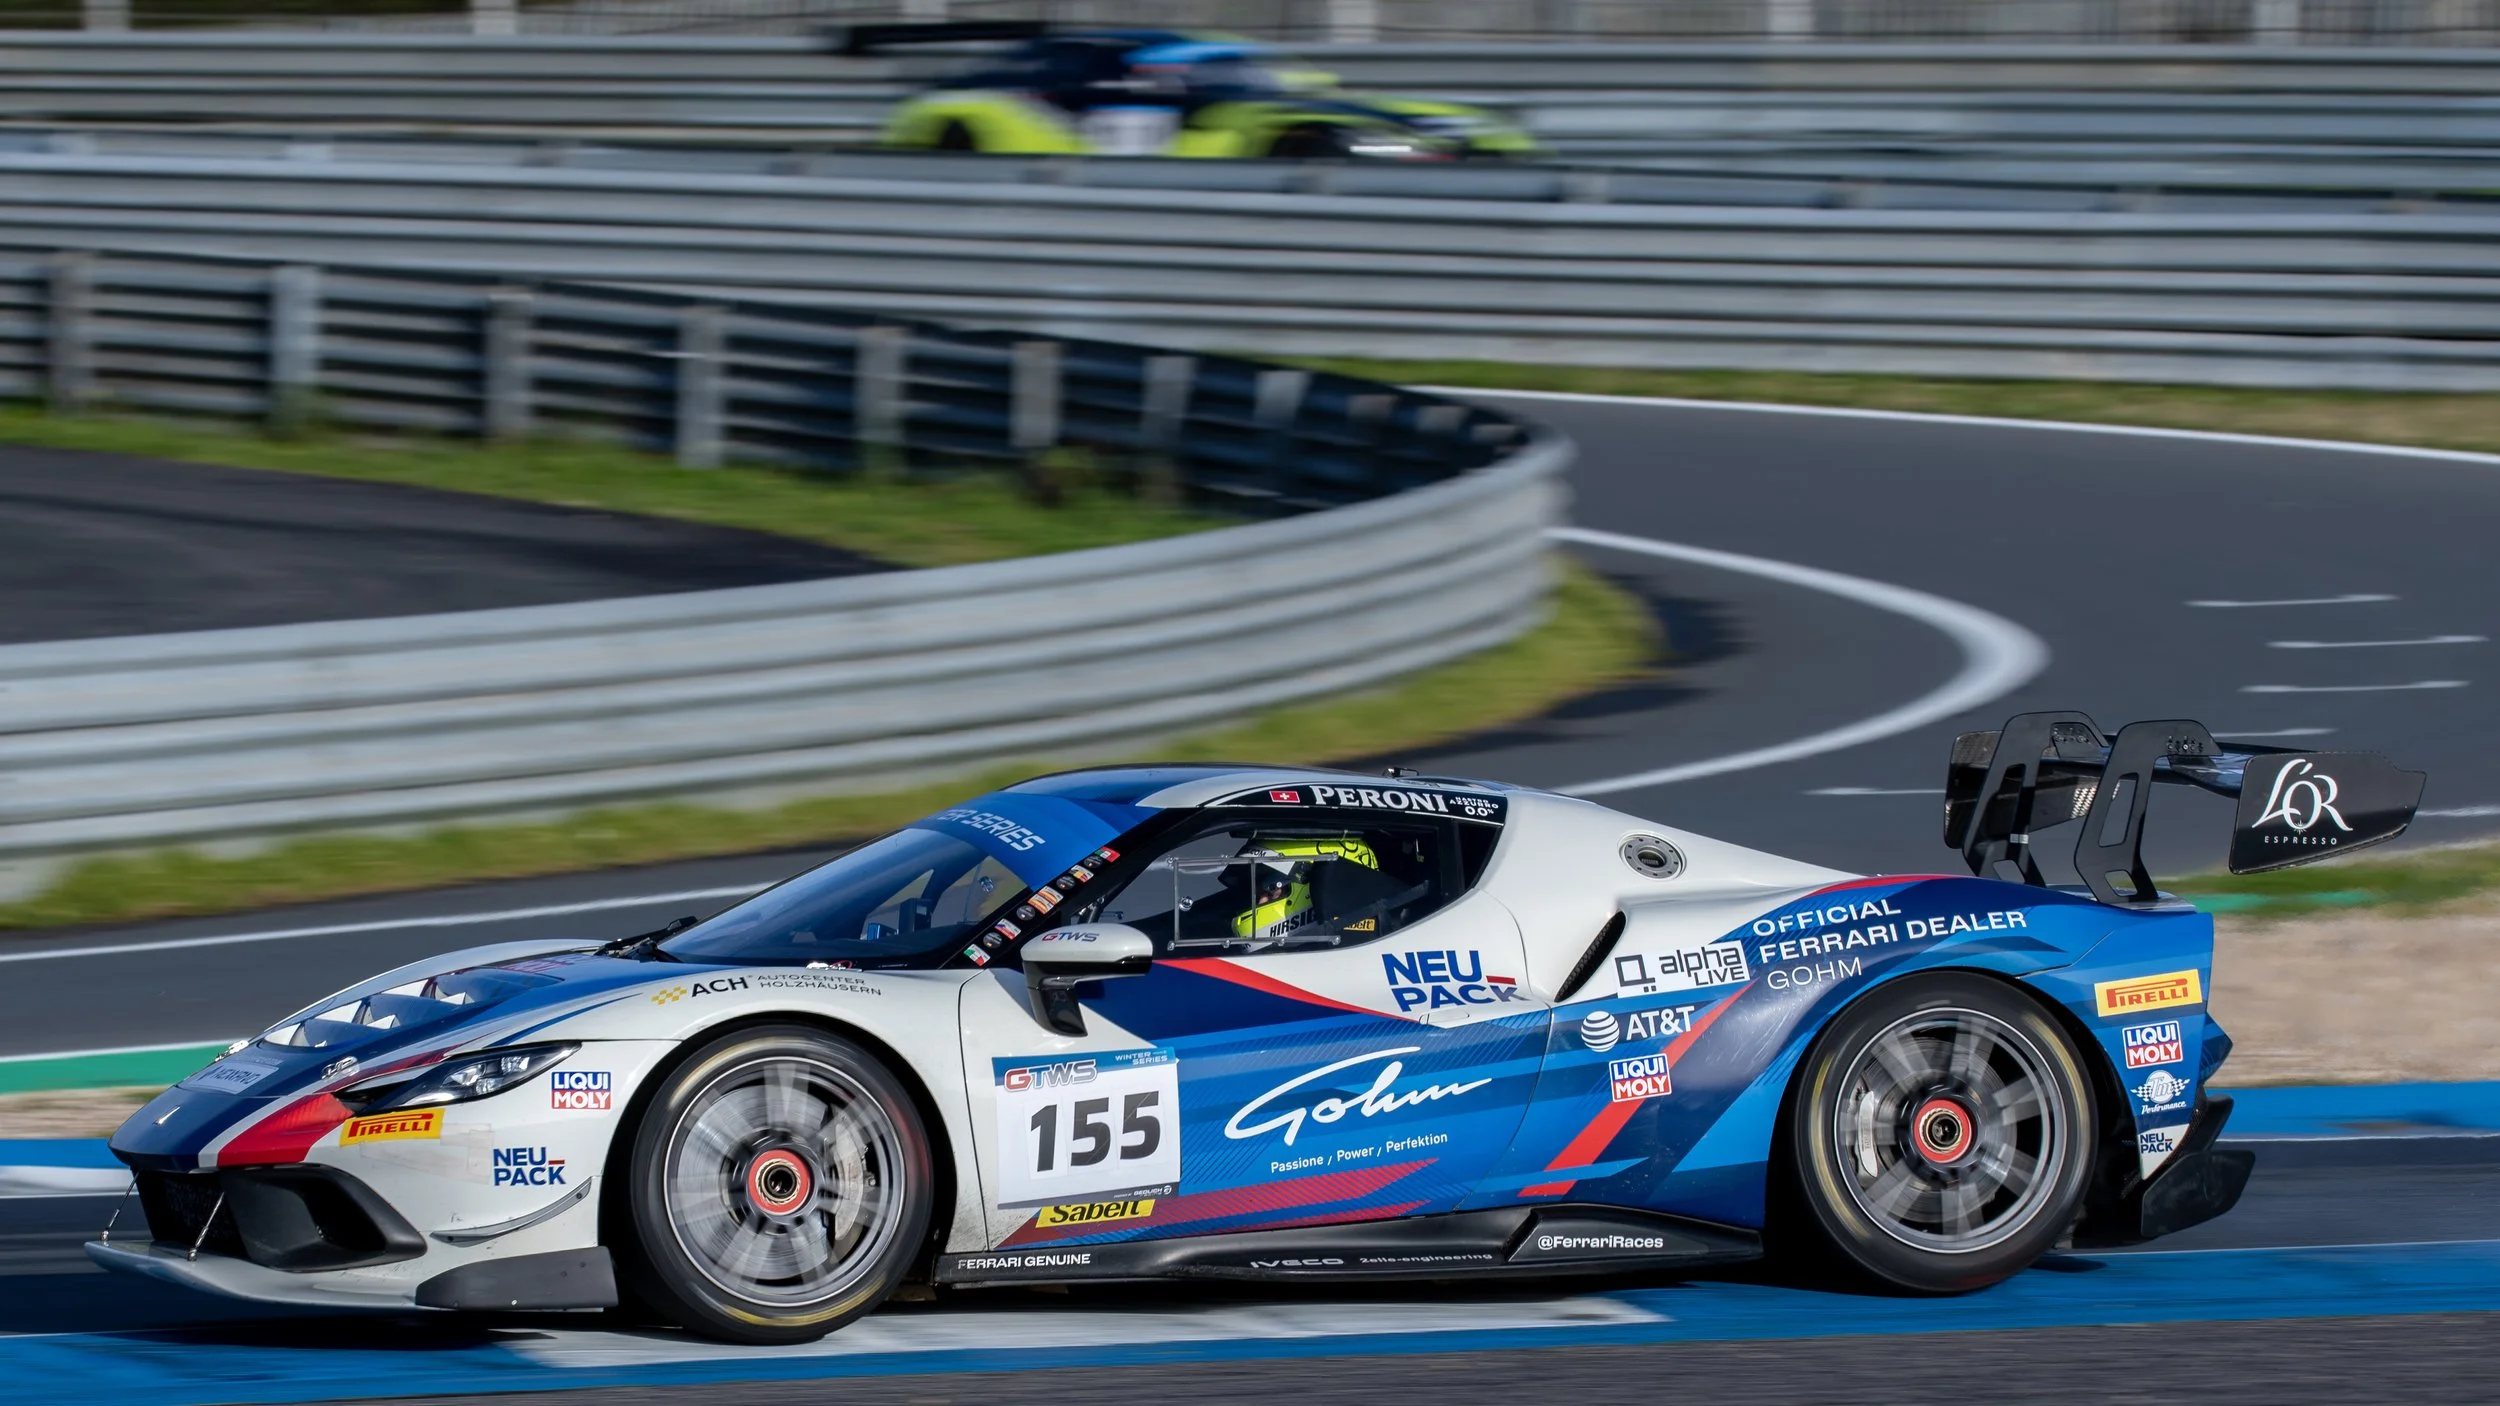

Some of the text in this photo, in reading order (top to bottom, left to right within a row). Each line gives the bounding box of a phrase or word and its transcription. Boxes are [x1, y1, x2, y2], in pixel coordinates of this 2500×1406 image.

[1308, 785, 1449, 813] PERONI
[961, 812, 1046, 851] SERIES
[2264, 835, 2338, 846] ESPRESSO
[1752, 899, 1902, 937] OFFICIAL
[1041, 932, 1100, 942] GTWS
[1759, 911, 2028, 964] FERRARI DEALER
[1658, 946, 1742, 977] alpha
[1767, 957, 1863, 990] GOHM
[757, 974, 865, 985] AUTOCENTER
[1693, 966, 1745, 986] LIVE
[1391, 984, 1533, 1013] PACK
[2105, 978, 2189, 1009] PIRELLI
[1626, 1005, 1695, 1041] AT&T
[2126, 1023, 2176, 1047] LIQUI
[1115, 1052, 1152, 1062] WINTER
[1132, 1056, 1168, 1065] SERIES
[2128, 1042, 2180, 1066] MOLY
[1004, 1060, 1099, 1091] GTWS
[1613, 1057, 1665, 1080] LIQUI
[553, 1072, 610, 1091] LIQUI
[1614, 1075, 1669, 1099] MOLY
[553, 1091, 611, 1110] MOLY
[1224, 1046, 1493, 1147] Gohm
[2141, 1100, 2187, 1115] Performance
[348, 1112, 434, 1138] PIRELLI
[1030, 1090, 1161, 1172] 155
[1270, 1155, 1324, 1174] Passione
[1336, 1146, 1375, 1162] Power
[1386, 1132, 1448, 1154] Perfektion
[2140, 1140, 2174, 1154] PACK
[494, 1166, 566, 1187] PACK
[1537, 1235, 1664, 1250] @FerrariRaces
[957, 1253, 1091, 1270] FERRARI GENUINE
